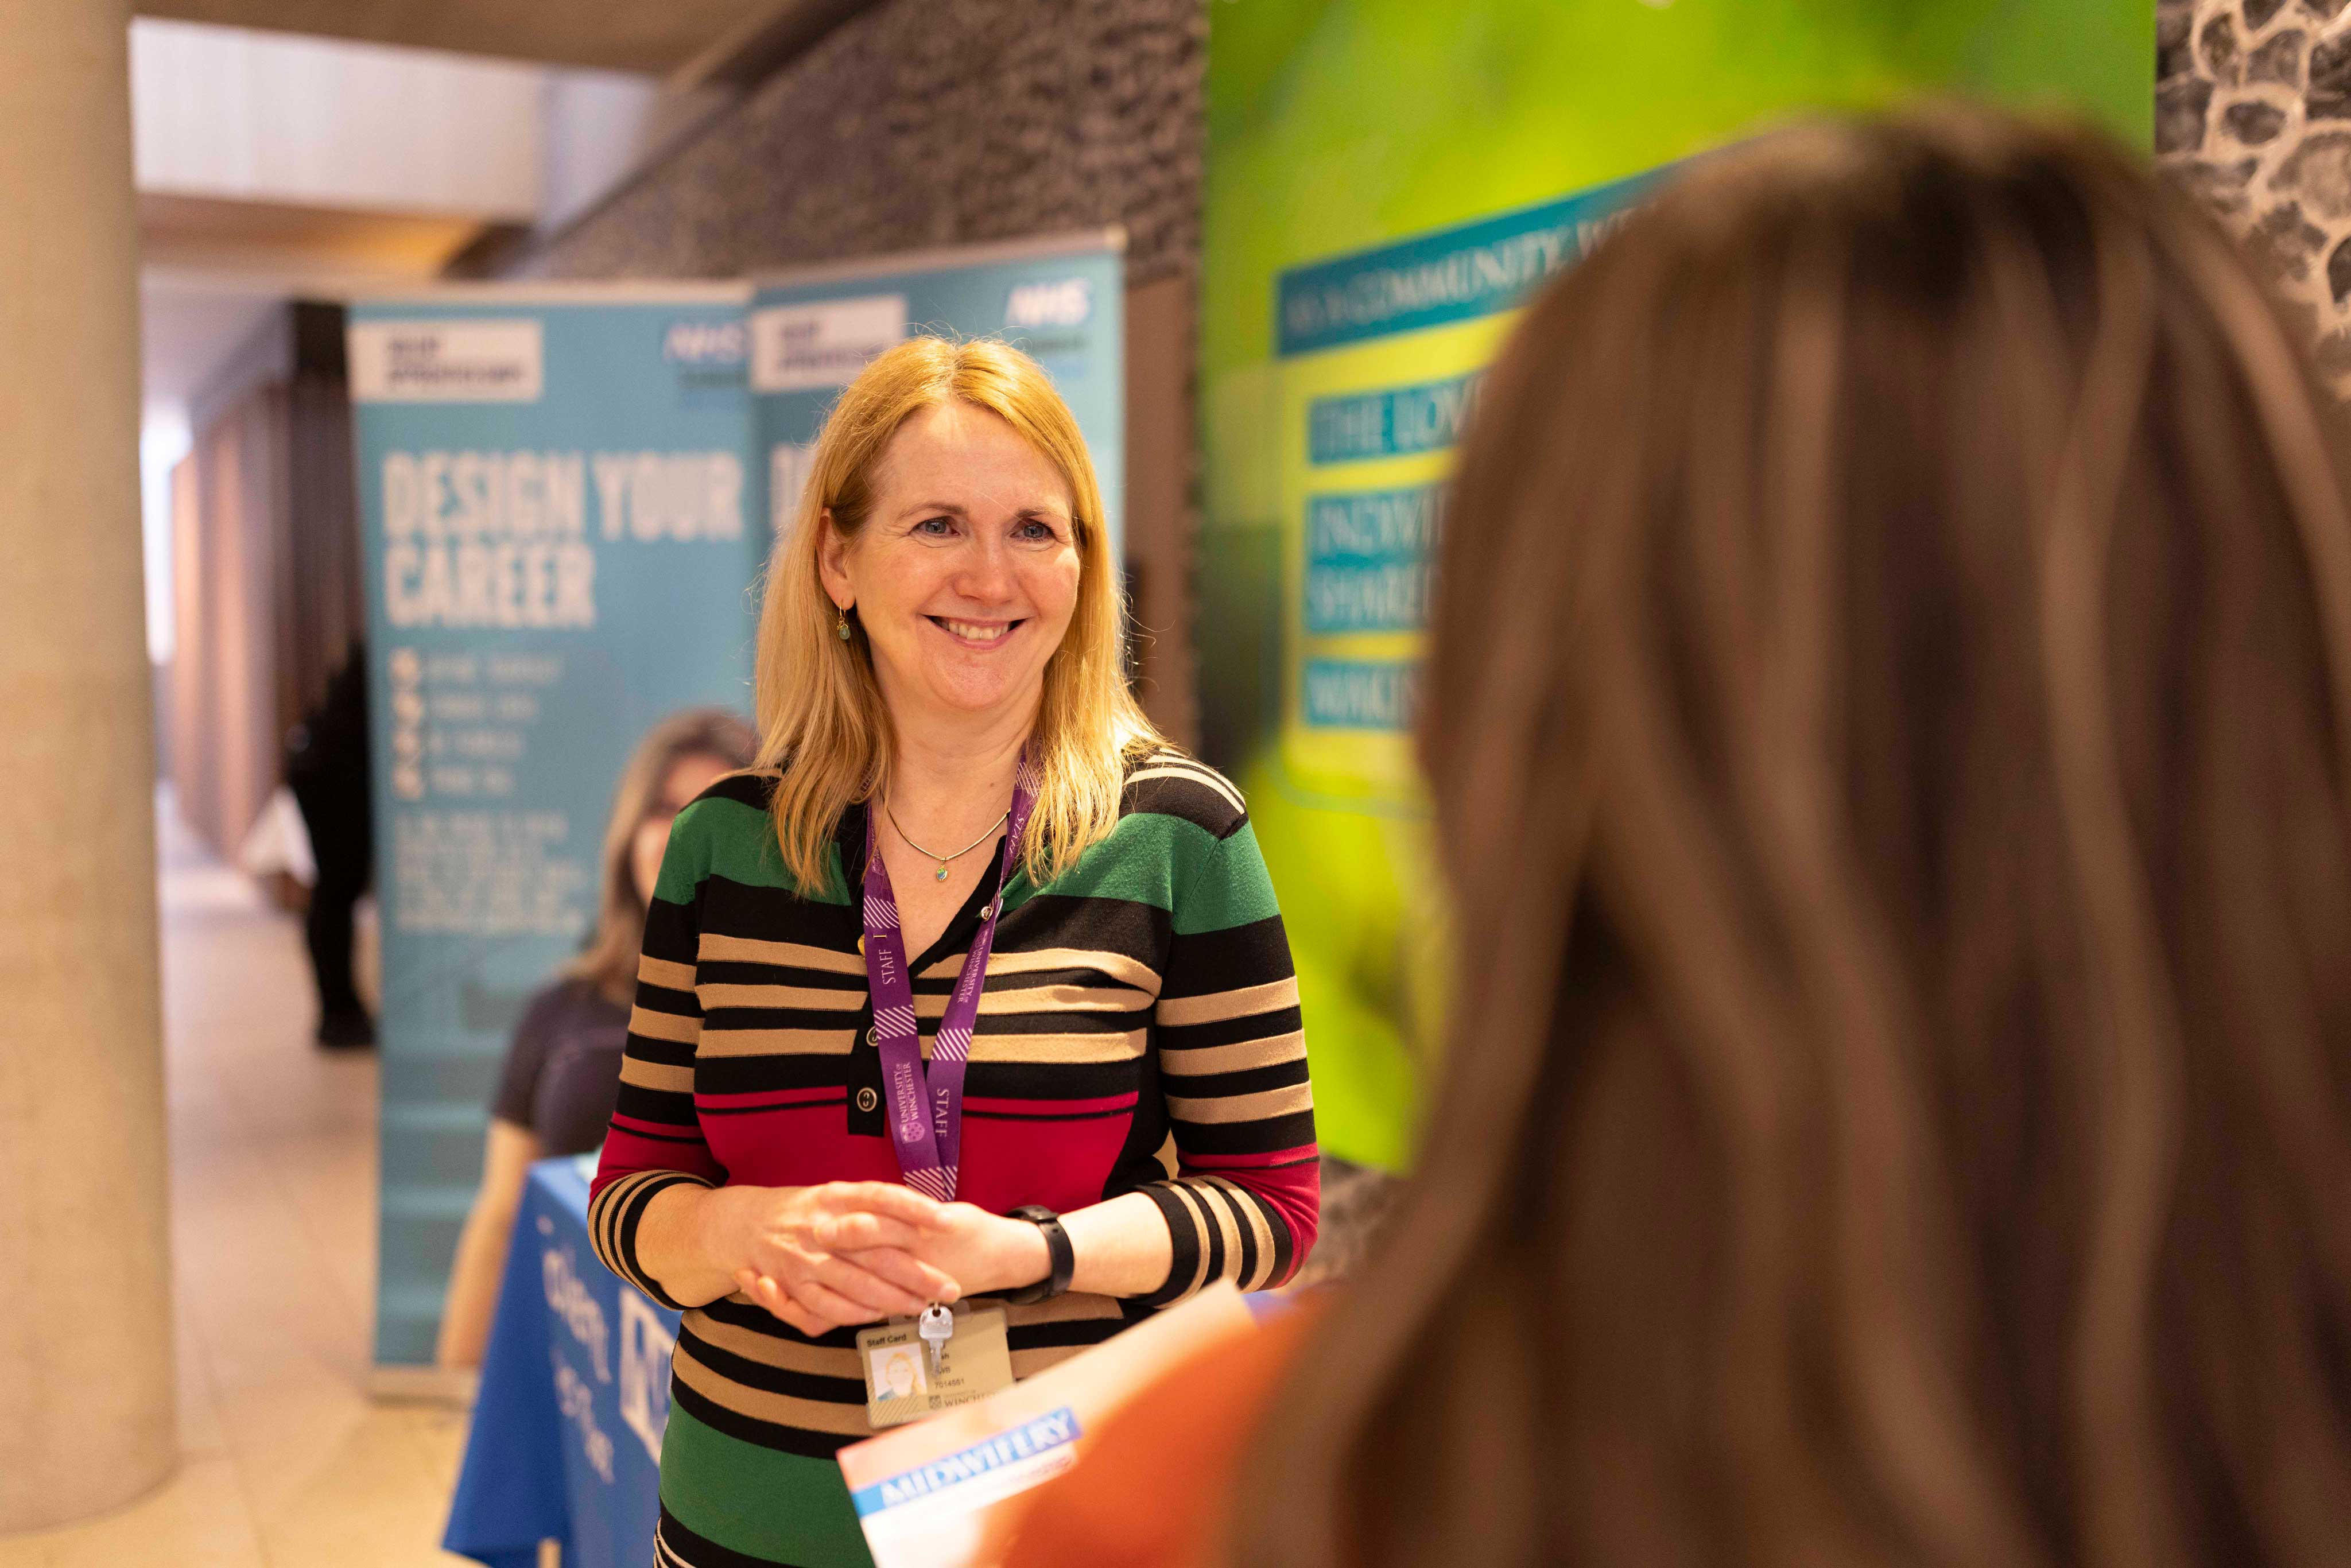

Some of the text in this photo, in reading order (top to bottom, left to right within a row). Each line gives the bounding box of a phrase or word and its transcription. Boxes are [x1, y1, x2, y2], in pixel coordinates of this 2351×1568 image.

[1006, 280, 1088, 326] NHS
[663, 324, 746, 362] NHS
[1391, 376, 1485, 448] LOV
[383, 452, 584, 542] DESIGN
[591, 451, 743, 541] YOUR
[385, 544, 596, 628] CAREER
[1008, 813, 1025, 857] STAFF
[879, 949, 897, 985] STAFF
[956, 949, 977, 1004] WINCHESTER
[966, 947, 983, 997] UNIVERSITY
[894, 1070, 909, 1123] UNIVERSITY
[902, 1062, 919, 1121] WINCHESTER
[935, 1088, 951, 1138] STAFF
[867, 1333, 907, 1348] Staff Card
[879, 1412, 1071, 1508] MIDWIFERY
